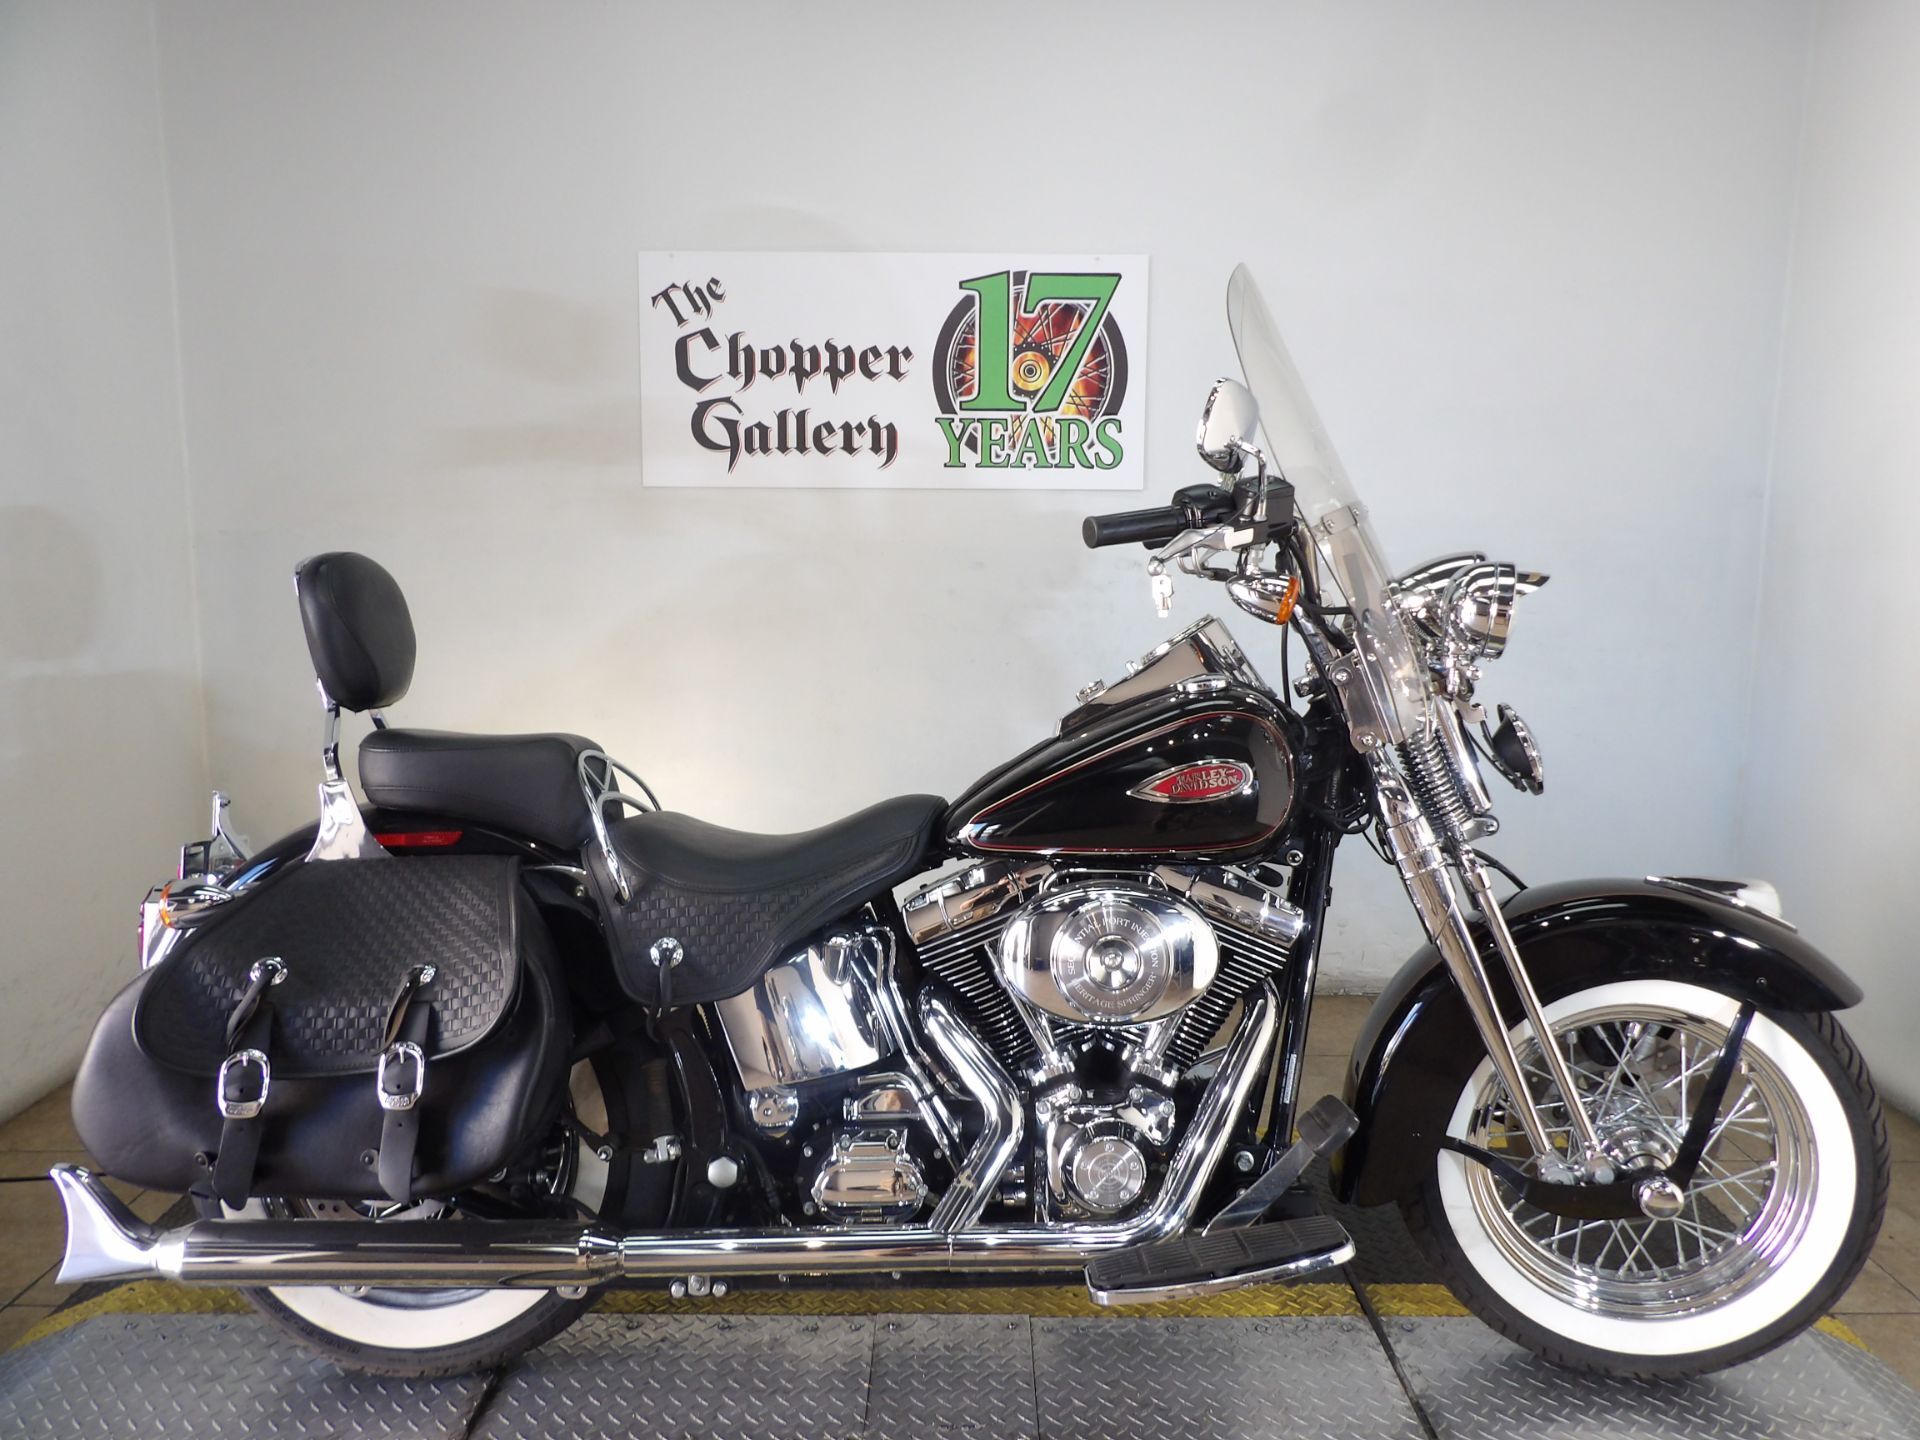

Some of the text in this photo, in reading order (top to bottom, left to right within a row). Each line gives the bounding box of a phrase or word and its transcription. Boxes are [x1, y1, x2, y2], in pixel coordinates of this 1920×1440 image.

[651, 276, 727, 328] The
[674, 327, 914, 395] Chopper
[959, 270, 1122, 412] 17
[690, 396, 899, 475] Gallery
[935, 417, 1125, 470] YEARS
